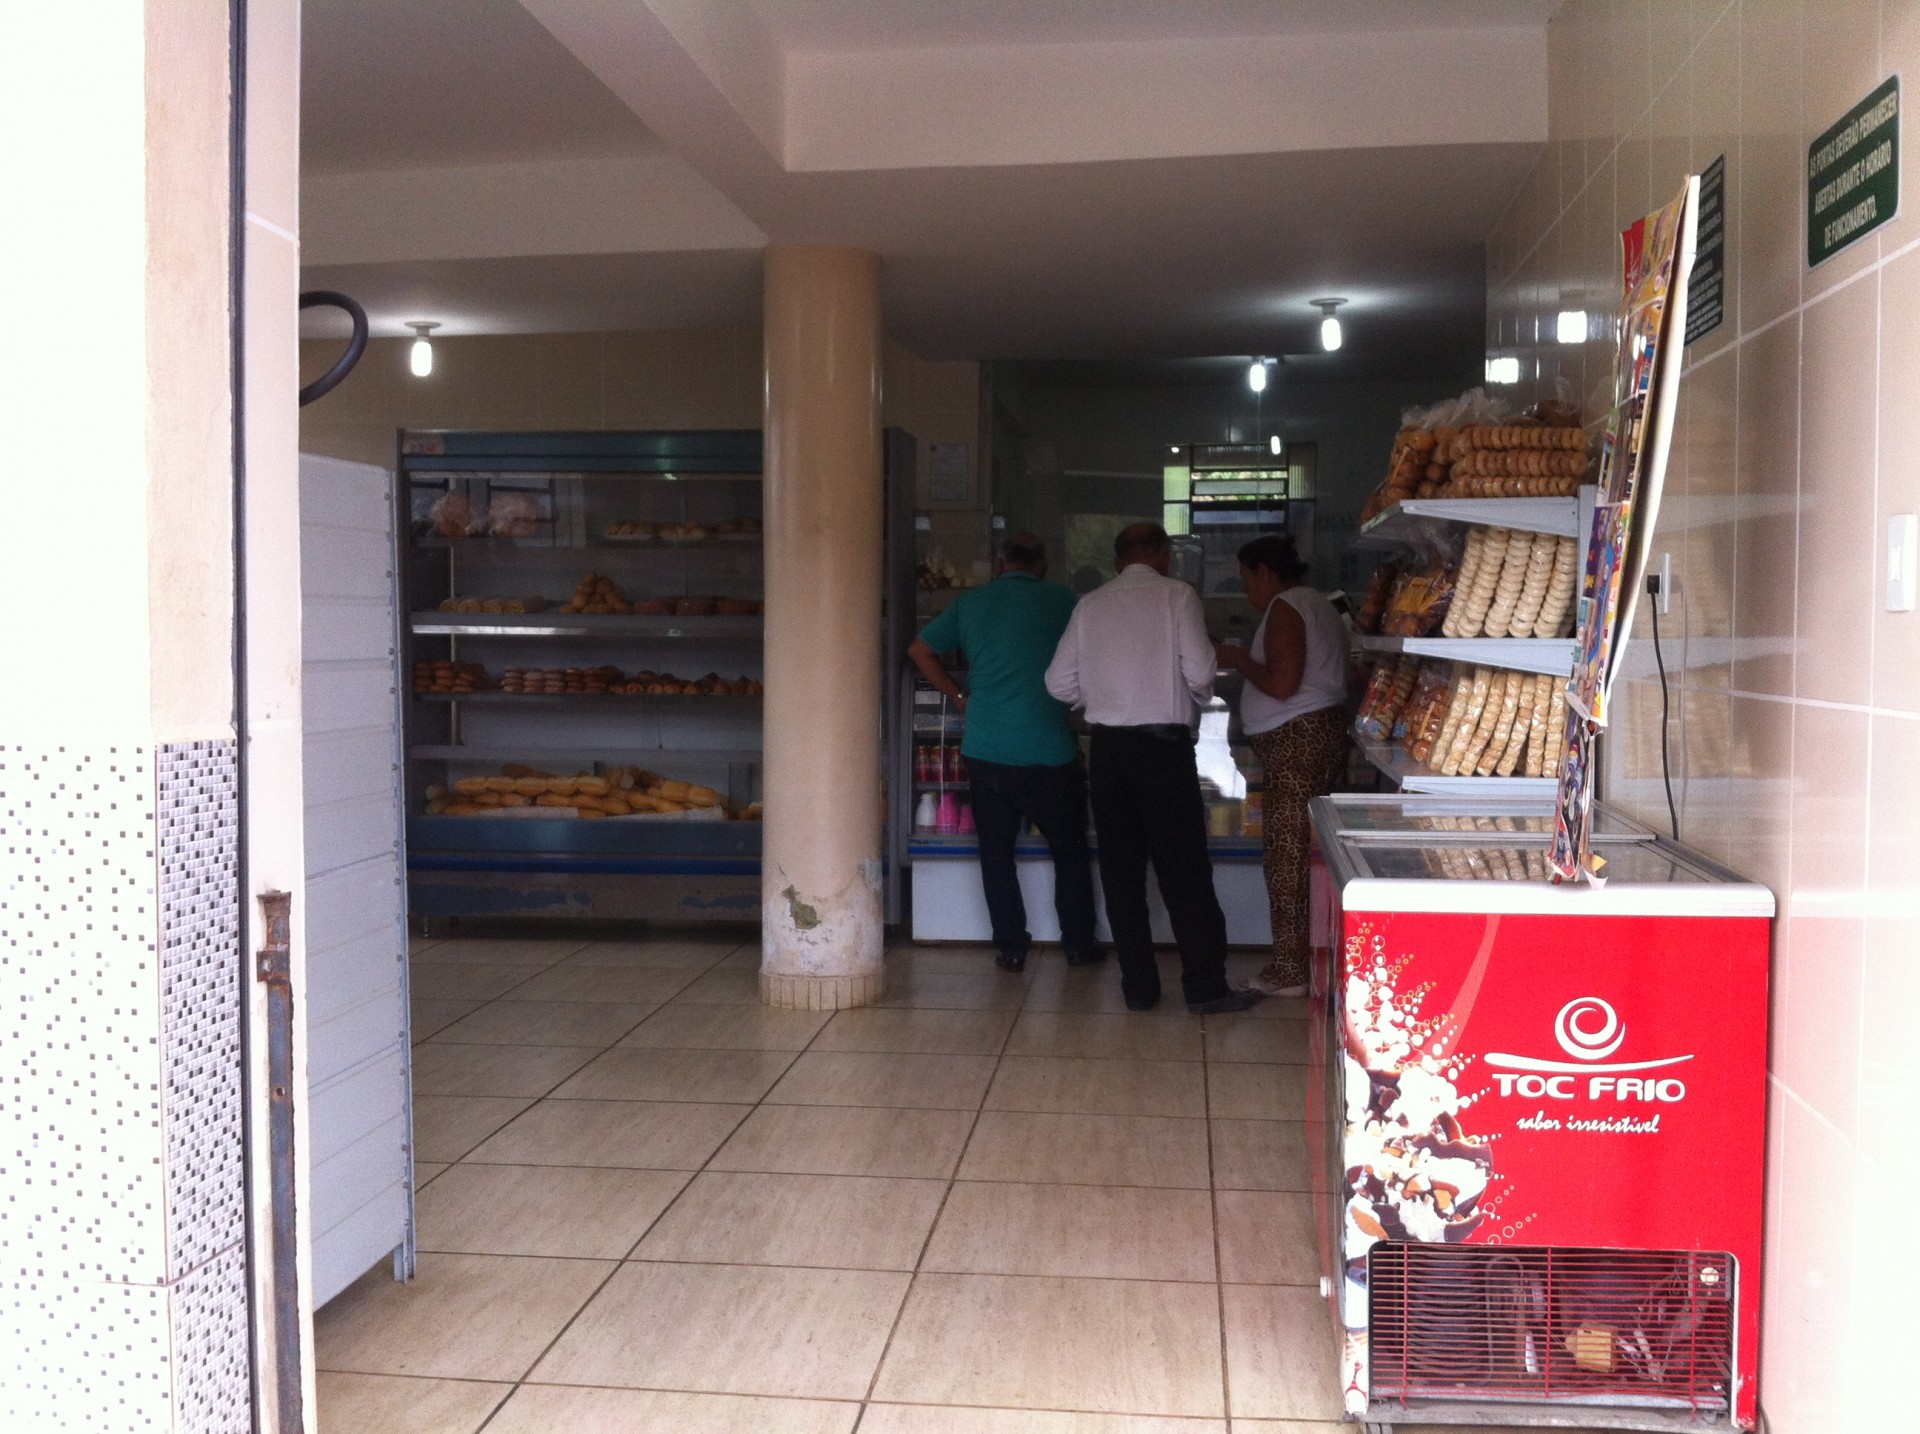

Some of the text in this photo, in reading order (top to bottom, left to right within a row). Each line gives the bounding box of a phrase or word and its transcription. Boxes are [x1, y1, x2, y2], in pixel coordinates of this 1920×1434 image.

[1816, 140, 1835, 172] PORTAS
[1835, 118, 1858, 161] DEVERÃO
[1859, 90, 1897, 140] PERMANECER
[1815, 138, 1892, 216] ABERTAS DURANTE O HORÁRIO
[1492, 1073, 1685, 1102] TOC FRIO
[1517, 1110, 1561, 1131] sabor
